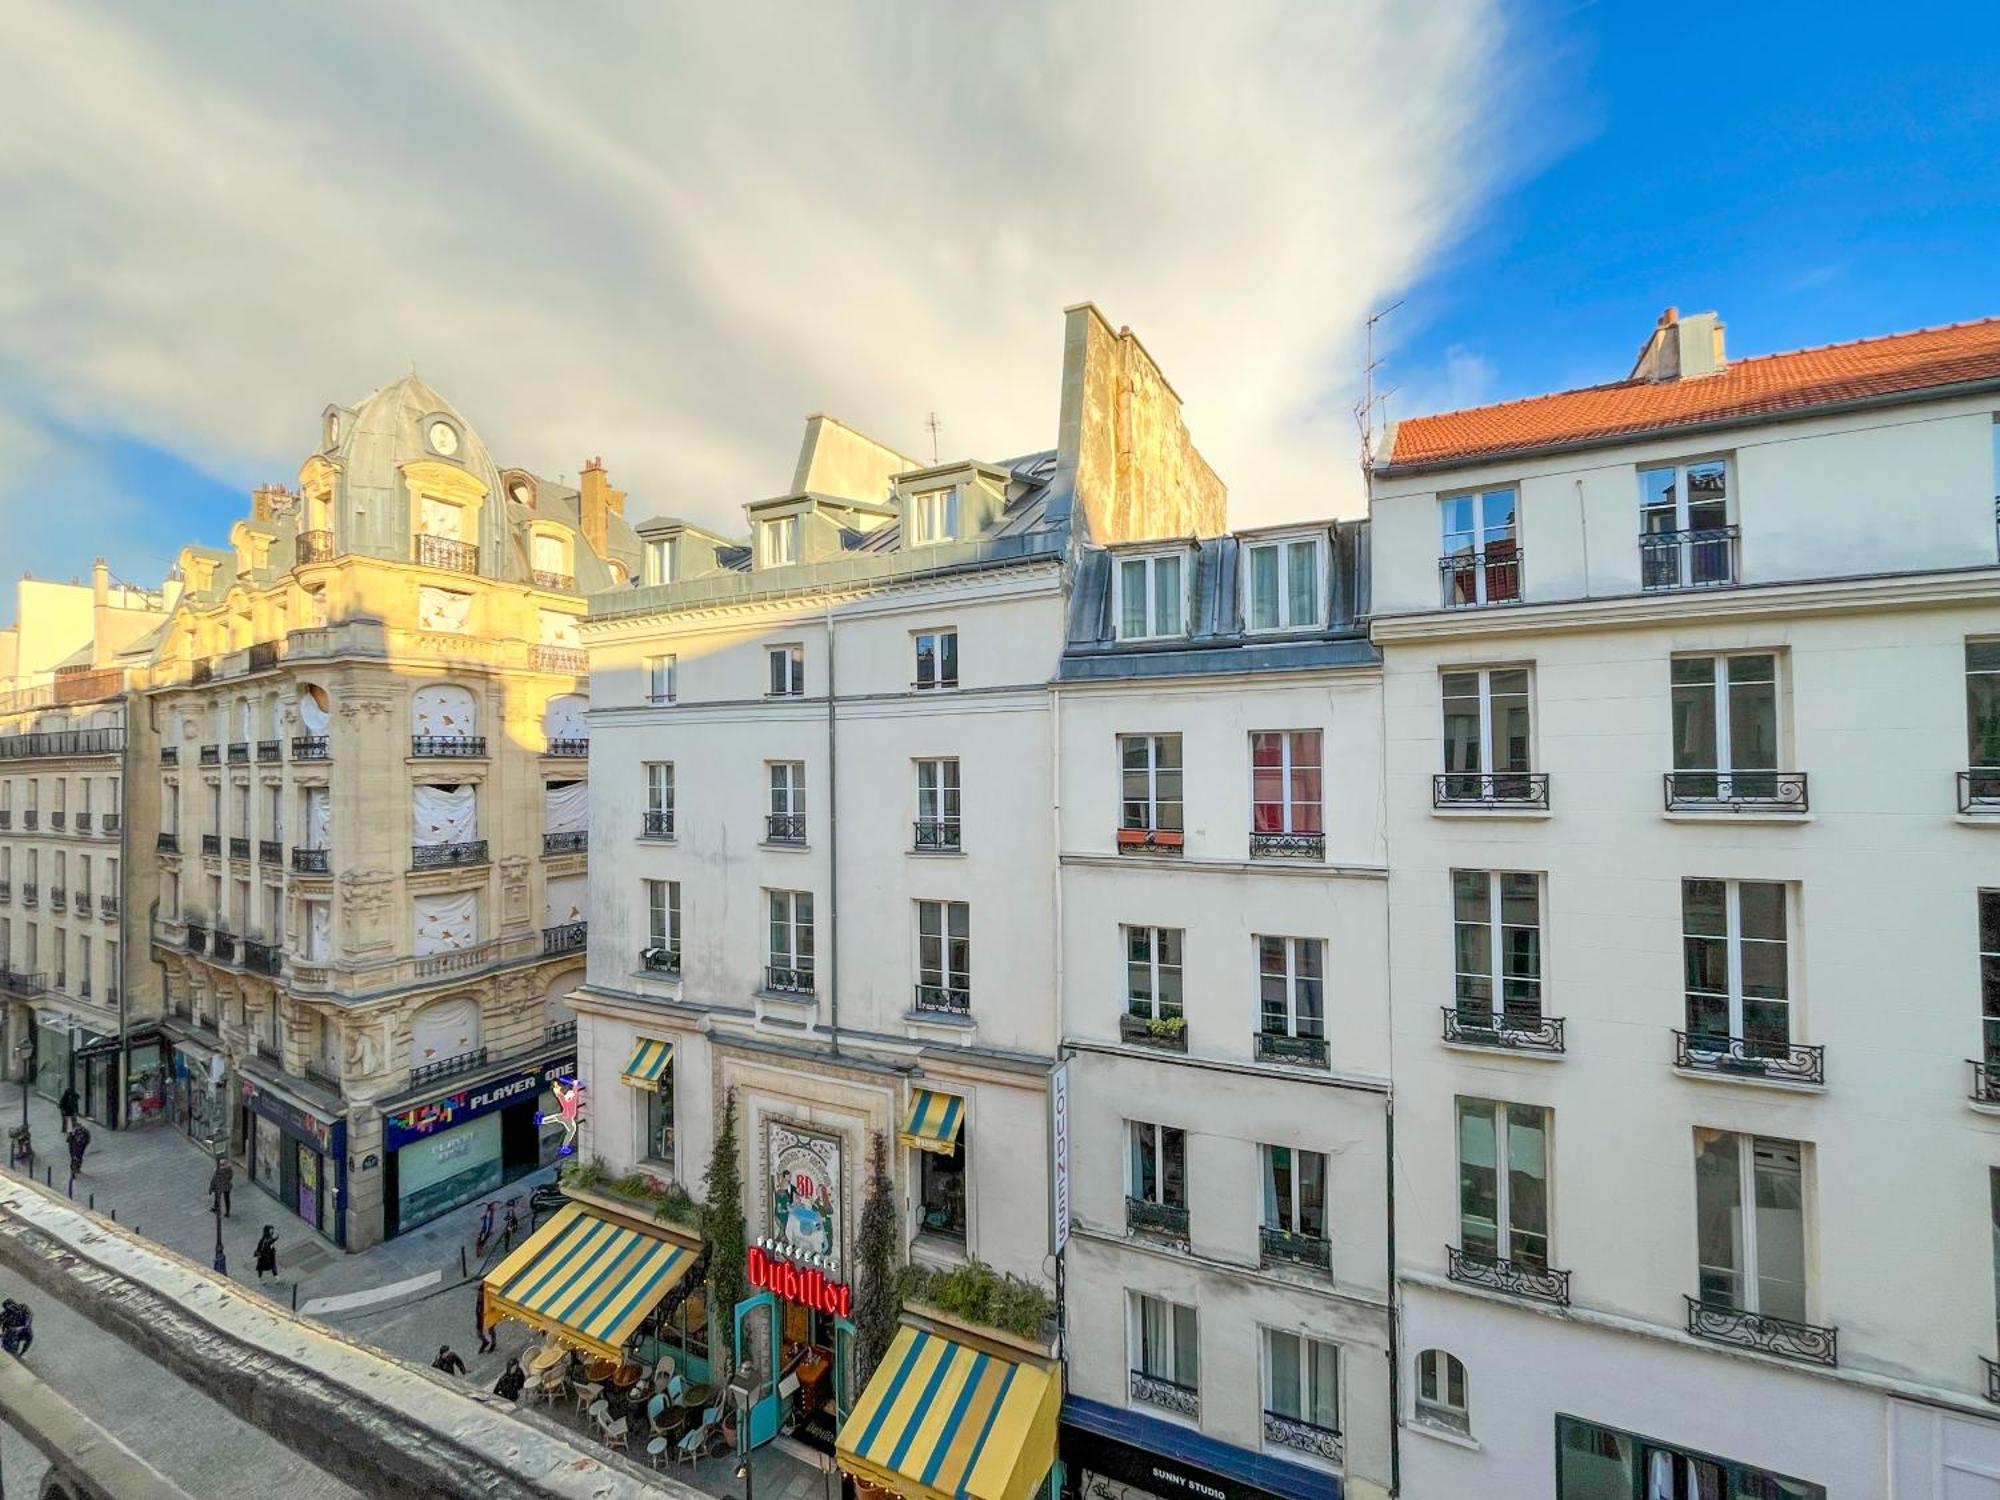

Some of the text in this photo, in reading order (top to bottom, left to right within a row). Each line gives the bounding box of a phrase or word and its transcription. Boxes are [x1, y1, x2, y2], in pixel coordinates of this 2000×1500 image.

[470, 1077, 536, 1109] PLAYER
[1056, 1076, 1066, 1242] LOUDNESS
[1153, 1467, 1226, 1500] SUNNY STUDIO
